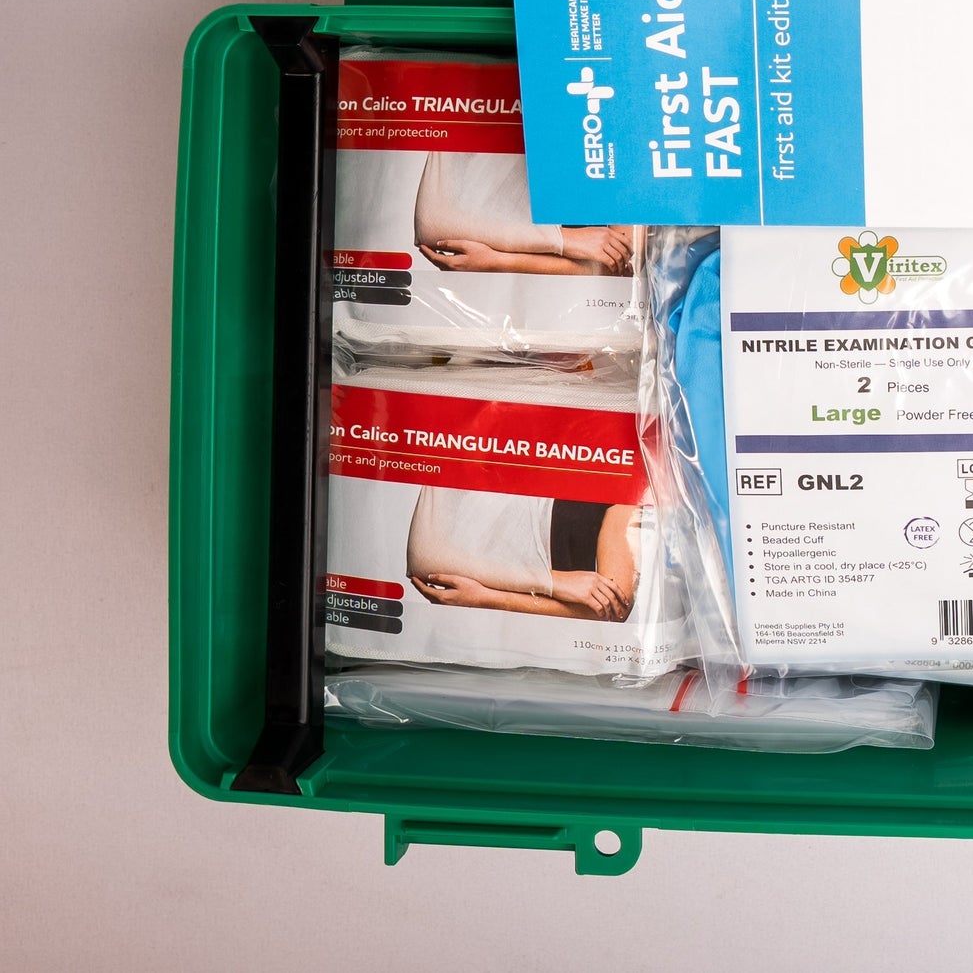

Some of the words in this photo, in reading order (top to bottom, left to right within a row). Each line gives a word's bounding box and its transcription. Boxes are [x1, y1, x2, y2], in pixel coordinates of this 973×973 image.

[582, 5, 590, 38] MAKE
[593, 13, 602, 50] BETTER
[582, 39, 590, 51] WE
[767, 51, 793, 85] kit
[336, 99, 358, 111] on
[362, 96, 407, 111] Calico
[412, 97, 523, 114] TRIANGULA
[770, 90, 794, 126] aid
[648, 71, 692, 178] First
[701, 66, 742, 178] FAST
[582, 115, 605, 179] AERO
[772, 132, 796, 181] first
[608, 142, 616, 179] Healthcare
[852, 252, 942, 283] Viritex
[742, 339, 818, 353] NITRILE
[824, 337, 960, 352] EXAMINATION
[858, 377, 872, 393] 2
[887, 381, 930, 393] Pieces
[812, 405, 882, 425] Large
[896, 409, 945, 421] Powder
[350, 424, 399, 443] Calico
[403, 429, 530, 457] TRIANGULAR
[536, 442, 634, 466] BANDAGE
[741, 475, 776, 489] REF
[798, 475, 864, 491] GNL2
[761, 522, 806, 531] Puncture
[808, 522, 856, 531] Resistant
[910, 525, 936, 533] LATEX
[762, 536, 801, 545] Beaded
[804, 535, 824, 545] Cuff
[763, 549, 837, 559] Hypoallergenic
[765, 575, 788, 585] TGA
[790, 575, 822, 584] ARTG
[824, 575, 835, 583] ID
[838, 573, 876, 583] 354877
[766, 589, 794, 598] Made
[796, 589, 805, 597] in
[808, 589, 837, 597] China
[930, 637, 938, 645] 9
